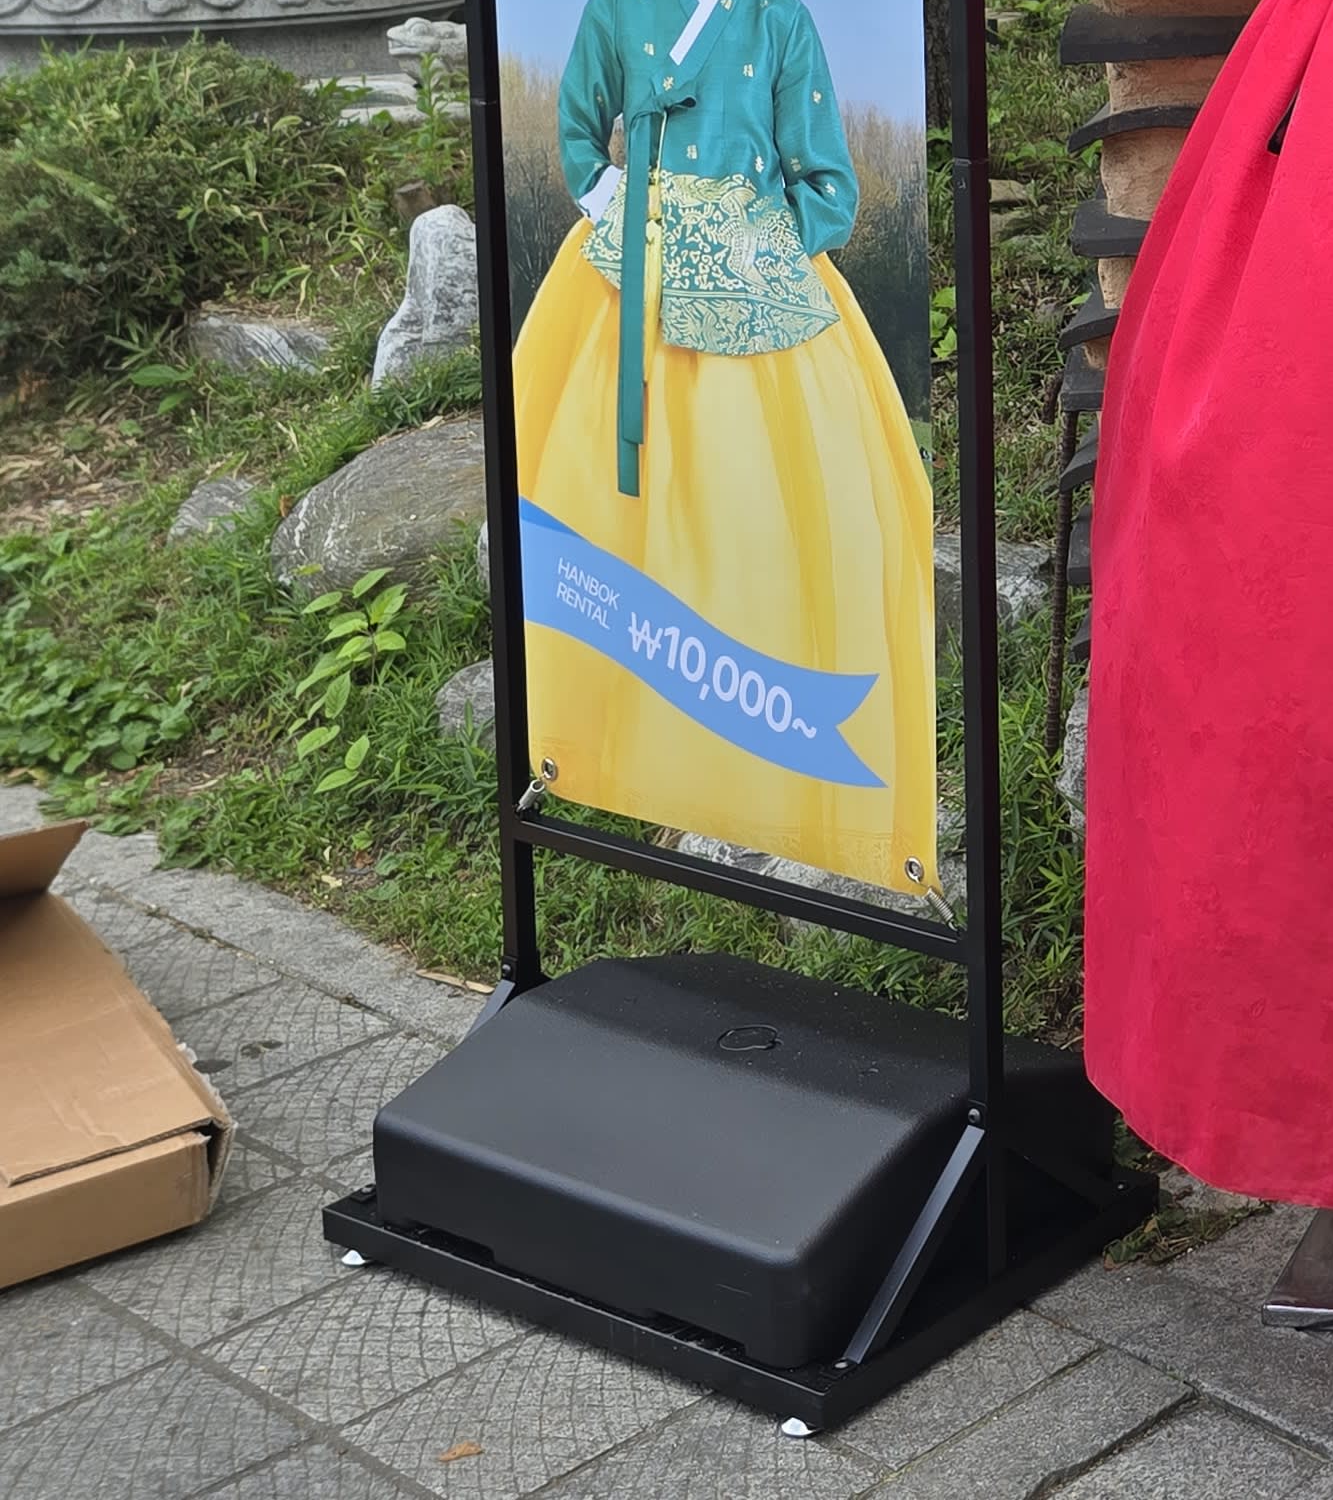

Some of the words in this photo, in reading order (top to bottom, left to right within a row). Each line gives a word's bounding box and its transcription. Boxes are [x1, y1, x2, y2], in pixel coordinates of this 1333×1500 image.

[555, 582, 611, 630] RENTAL
[557, 557, 621, 612] HANBOK
[628, 611, 818, 741] ₩10,000~
